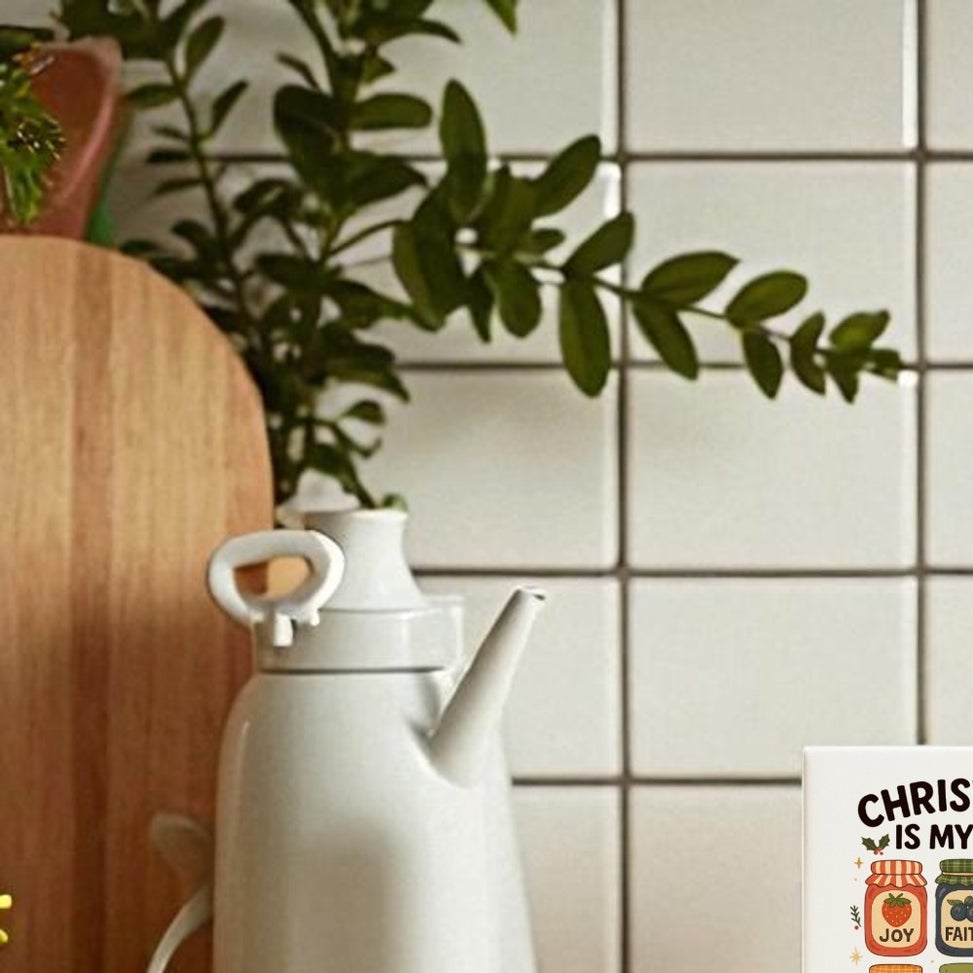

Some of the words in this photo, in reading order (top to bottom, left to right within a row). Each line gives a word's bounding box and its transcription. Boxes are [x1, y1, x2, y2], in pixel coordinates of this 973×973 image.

[896, 823, 921, 850] IS
[929, 824, 973, 850] MY
[879, 928, 915, 943] JOY
